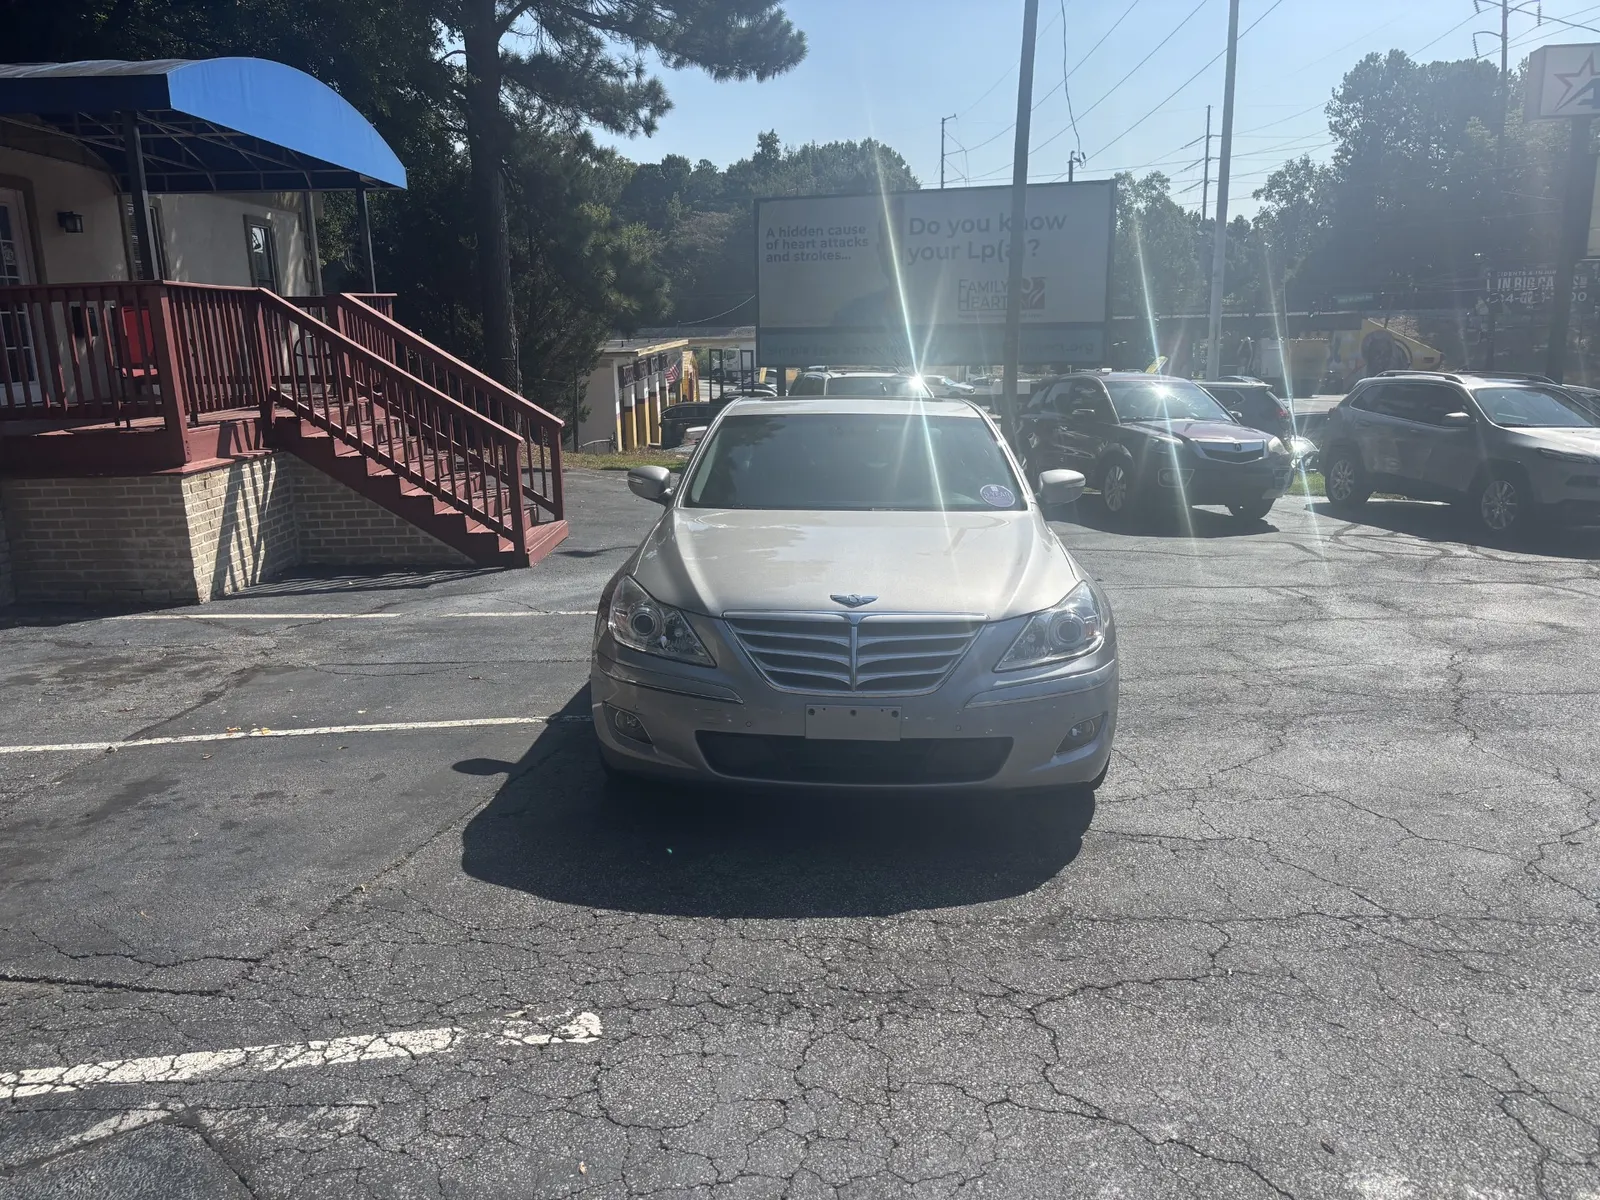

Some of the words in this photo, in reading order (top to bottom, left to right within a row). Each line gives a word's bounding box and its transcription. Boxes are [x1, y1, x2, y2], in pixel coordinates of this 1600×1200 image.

[766, 227, 776, 239] A
[778, 226, 824, 239] hidden
[828, 225, 866, 237] cause
[908, 217, 941, 236] Do
[948, 218, 990, 238] you
[999, 212, 1067, 232] kow
[766, 239, 781, 250] of
[783, 237, 817, 249] heart
[820, 236, 869, 248] attacks
[766, 251, 791, 263] and
[793, 250, 852, 262] strokes...
[907, 243, 960, 266] your
[958, 278, 1009, 294] FAMILY
[958, 292, 1008, 309] HEART
